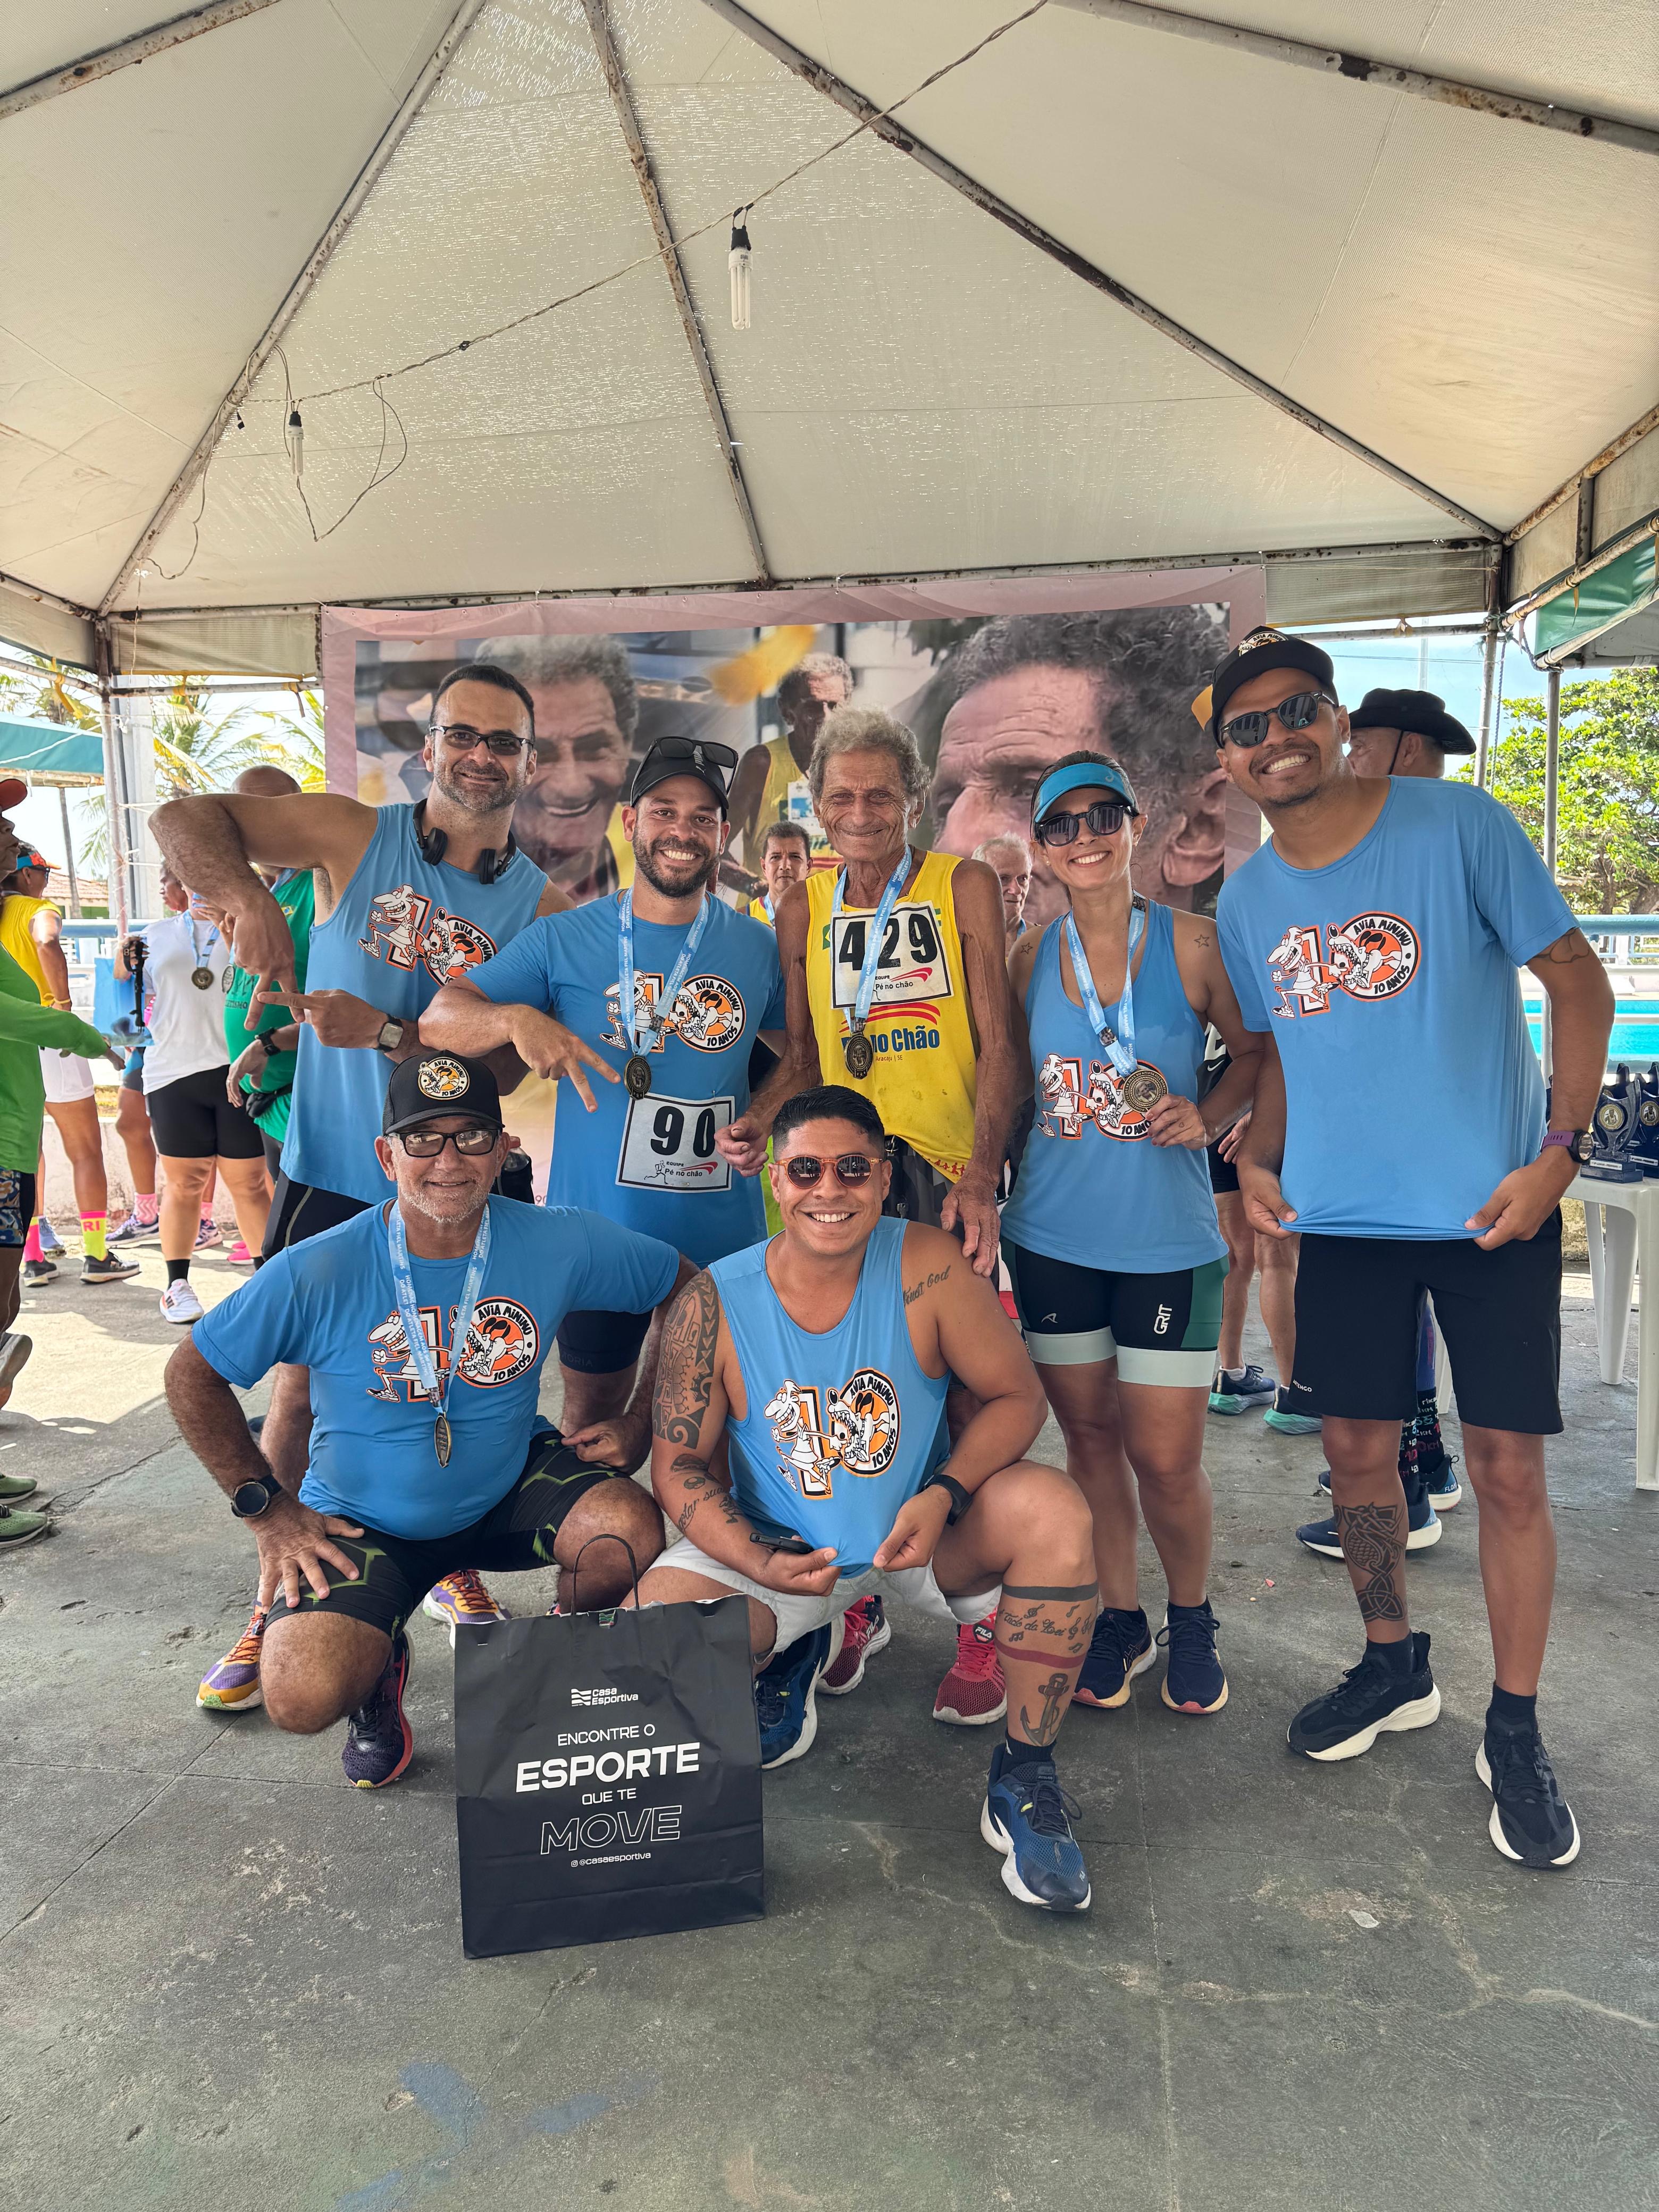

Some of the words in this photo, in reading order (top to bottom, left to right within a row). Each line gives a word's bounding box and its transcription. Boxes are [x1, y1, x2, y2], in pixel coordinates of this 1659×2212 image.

[839, 914, 937, 970] 429
[859, 975, 870, 1009] HOMENAGEM
[874, 915, 884, 934] ATLETA
[1073, 944, 1082, 962] ATLETA
[673, 960, 683, 977] ATLETA
[1373, 983, 1385, 994] 10
[1387, 965, 1410, 991] ANOS
[707, 1037, 717, 1046] 10
[718, 1026, 738, 1046] ANOS
[891, 1025, 940, 1052] Chão
[650, 1106, 716, 1158] 90
[1121, 1125, 1133, 1135] 10
[1134, 1120, 1152, 1135] ANO
[397, 1244, 405, 1269] MARTINS
[478, 1249, 484, 1258] DO
[399, 1279, 406, 1288] DO
[927, 1265, 951, 1287] God
[458, 1304, 467, 1325] ATLETA
[466, 1266, 477, 1292] MARTINS
[404, 1308, 412, 1318] DO
[406, 1317, 417, 1338] ATLETA
[409, 1303, 424, 1342] HOMENAGEM
[420, 1341, 428, 1354] AOS
[412, 1338, 421, 1350] FIEL
[493, 1371, 505, 1381] 10
[507, 1353, 531, 1381] ANOS
[872, 1454, 884, 1468] 10
[884, 1428, 896, 1460] ANOS
[975, 1627, 993, 1639] FILA
[1024, 1619, 1038, 1631] da
[592, 1688, 617, 1697] Casa
[592, 1694, 639, 1706] Esportiva
[558, 1725, 639, 1746] ENCONTRE
[643, 1724, 656, 1736] O
[516, 1742, 700, 1793] ESPORTE
[582, 1791, 613, 1805] QUE
[617, 1788, 636, 1800] TE
[540, 1805, 682, 1855] MOVE
[579, 1853, 651, 1866] @casaesportiva
